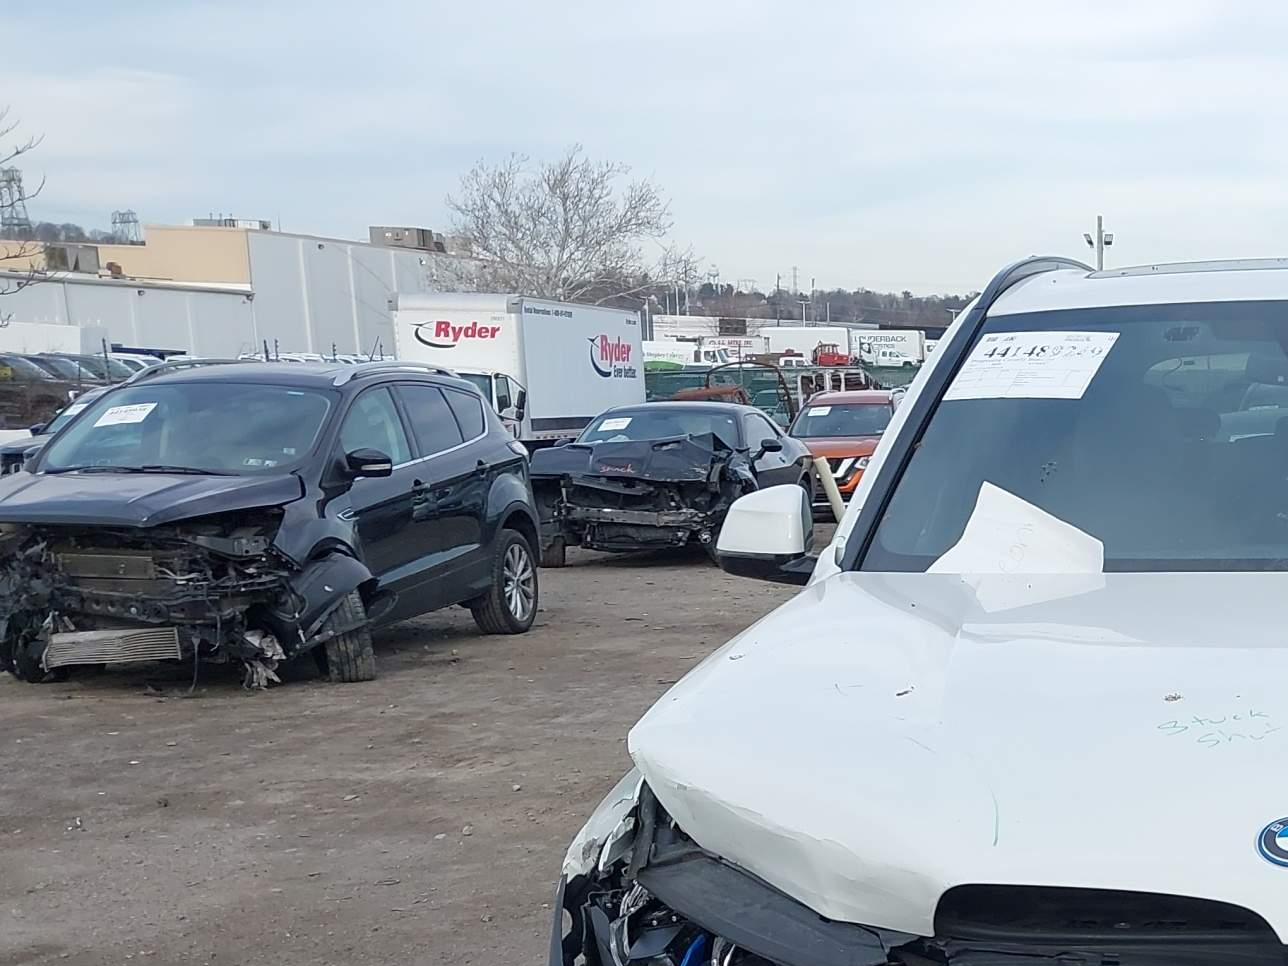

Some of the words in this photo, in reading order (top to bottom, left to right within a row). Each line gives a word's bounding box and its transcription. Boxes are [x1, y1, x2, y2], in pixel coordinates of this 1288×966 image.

[434, 321, 501, 342] Ryder
[600, 334, 632, 367] Ryder
[613, 365, 623, 379] Ever
